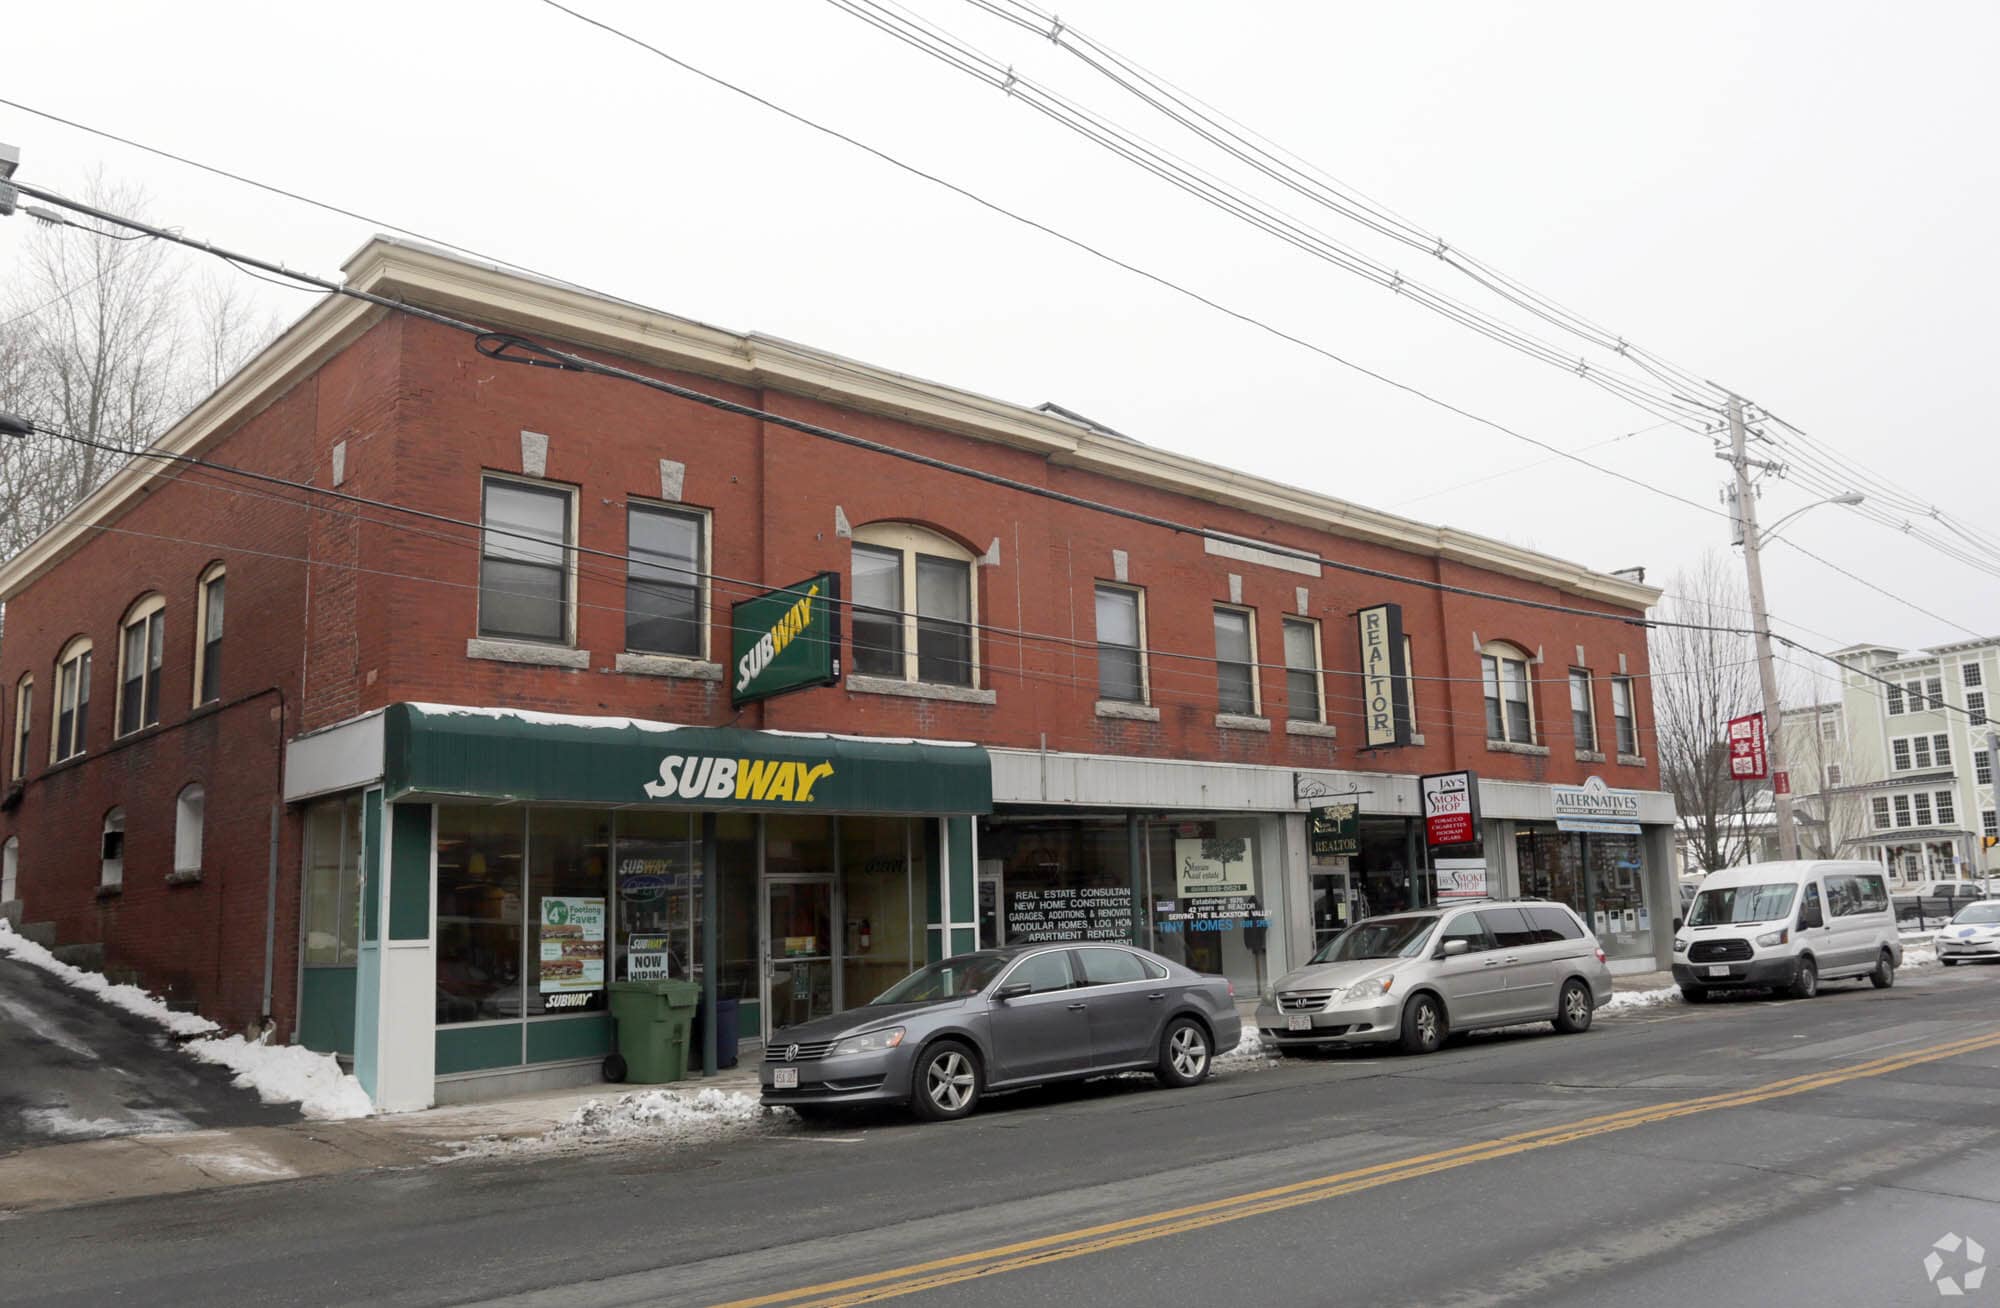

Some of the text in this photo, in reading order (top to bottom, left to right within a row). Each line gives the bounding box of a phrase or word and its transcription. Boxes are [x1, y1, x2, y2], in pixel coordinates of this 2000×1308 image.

[736, 584, 819, 693] SUBWAY
[1366, 613, 1389, 731] REALTOR
[643, 755, 834, 802] SUBWAY
[1556, 793, 1637, 809] ALTERNATIVES
[1432, 822, 1467, 830] CIGARETTES
[1434, 816, 1464, 824] TOBACCO
[1436, 828, 1463, 836] HOOKAH
[1315, 839, 1357, 852] REALTOR
[619, 859, 672, 875] SUBWAY
[1015, 888, 1131, 900] REAL ESTATE CONSULTAN
[569, 905, 601, 914] Footlong
[1014, 902, 1035, 911] NEW
[1040, 900, 1066, 909] HOME
[570, 915, 598, 924] Faves
[1008, 911, 1046, 921] GARAGES,
[1211, 910, 1249, 918] BLACKSTONE
[1251, 909, 1273, 917] VALLEY
[1011, 922, 1054, 932] MODULAR
[1094, 919, 1112, 928] LOG
[1157, 921, 1185, 933] TINY
[1190, 920, 1233, 932] HOMES
[1028, 929, 1126, 942] APARTMENT RENTALS
[630, 938, 667, 950] SUBWAY
[635, 955, 662, 968] NOW
[545, 992, 592, 1008] SUBWAY
